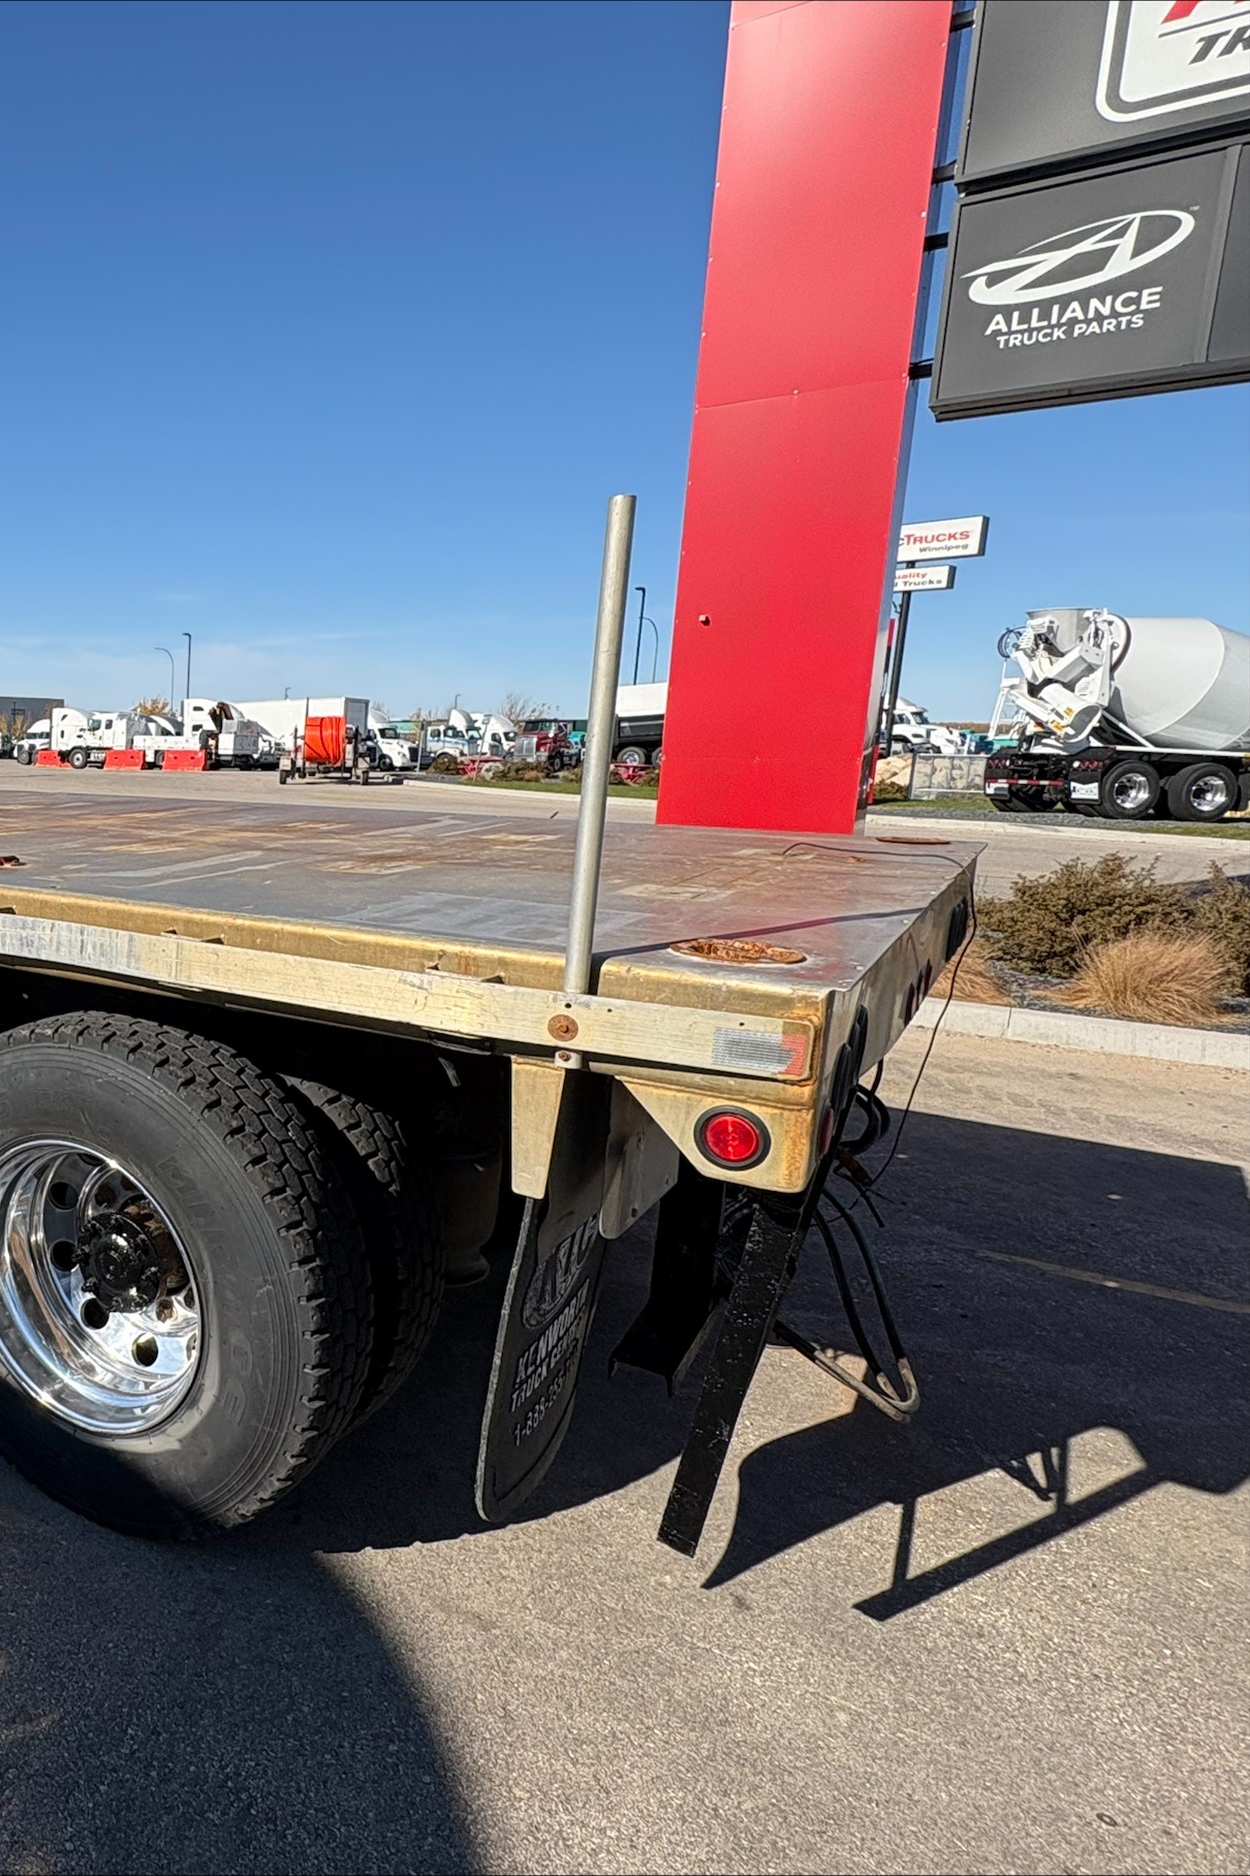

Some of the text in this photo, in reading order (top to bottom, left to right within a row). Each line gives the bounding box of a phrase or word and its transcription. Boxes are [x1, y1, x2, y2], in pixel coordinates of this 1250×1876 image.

[984, 286, 1163, 336] ALLIANCE
[996, 313, 1145, 349] TRUCK PARTS
[919, 543, 969, 553] Winnipeg
[516, 1277, 591, 1385] KENWORTH
[511, 1356, 550, 1413] TRUCK
